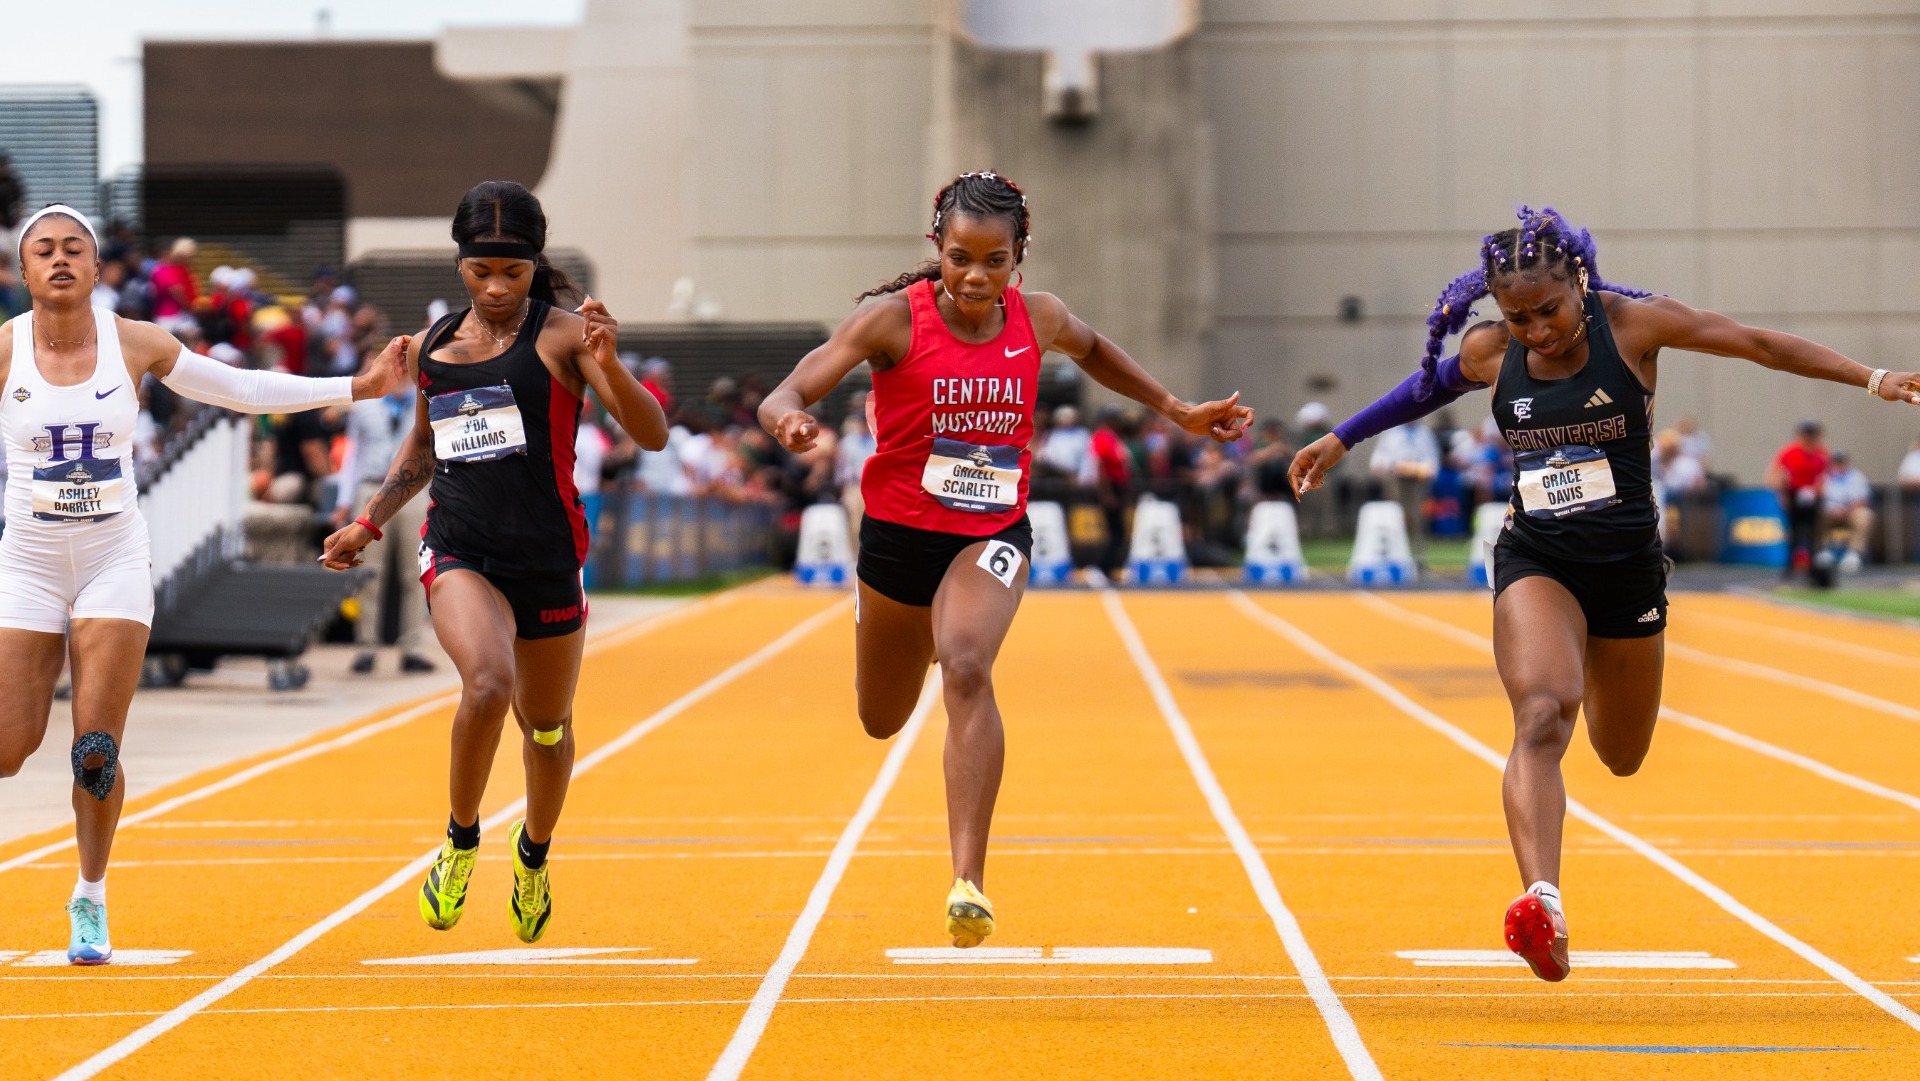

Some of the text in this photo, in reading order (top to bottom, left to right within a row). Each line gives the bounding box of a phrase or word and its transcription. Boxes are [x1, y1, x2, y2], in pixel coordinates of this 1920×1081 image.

[932, 377, 1025, 405] CENTRAL
[464, 417, 488, 434] J'DA
[931, 410, 1023, 435] MISSOURI
[1505, 414, 1627, 451] CONVERSE
[43, 420, 102, 462] H
[451, 430, 507, 453] WILLIAMS
[952, 464, 996, 481] GRIZELL
[1541, 468, 1583, 489] GRACE
[58, 487, 100, 500] ASHLEY
[942, 479, 1000, 499] SCARLETT
[1547, 486, 1584, 506] DAVIS
[54, 499, 102, 514] BARRETT
[989, 545, 1016, 578] 6
[1637, 614, 1660, 622] adidas
